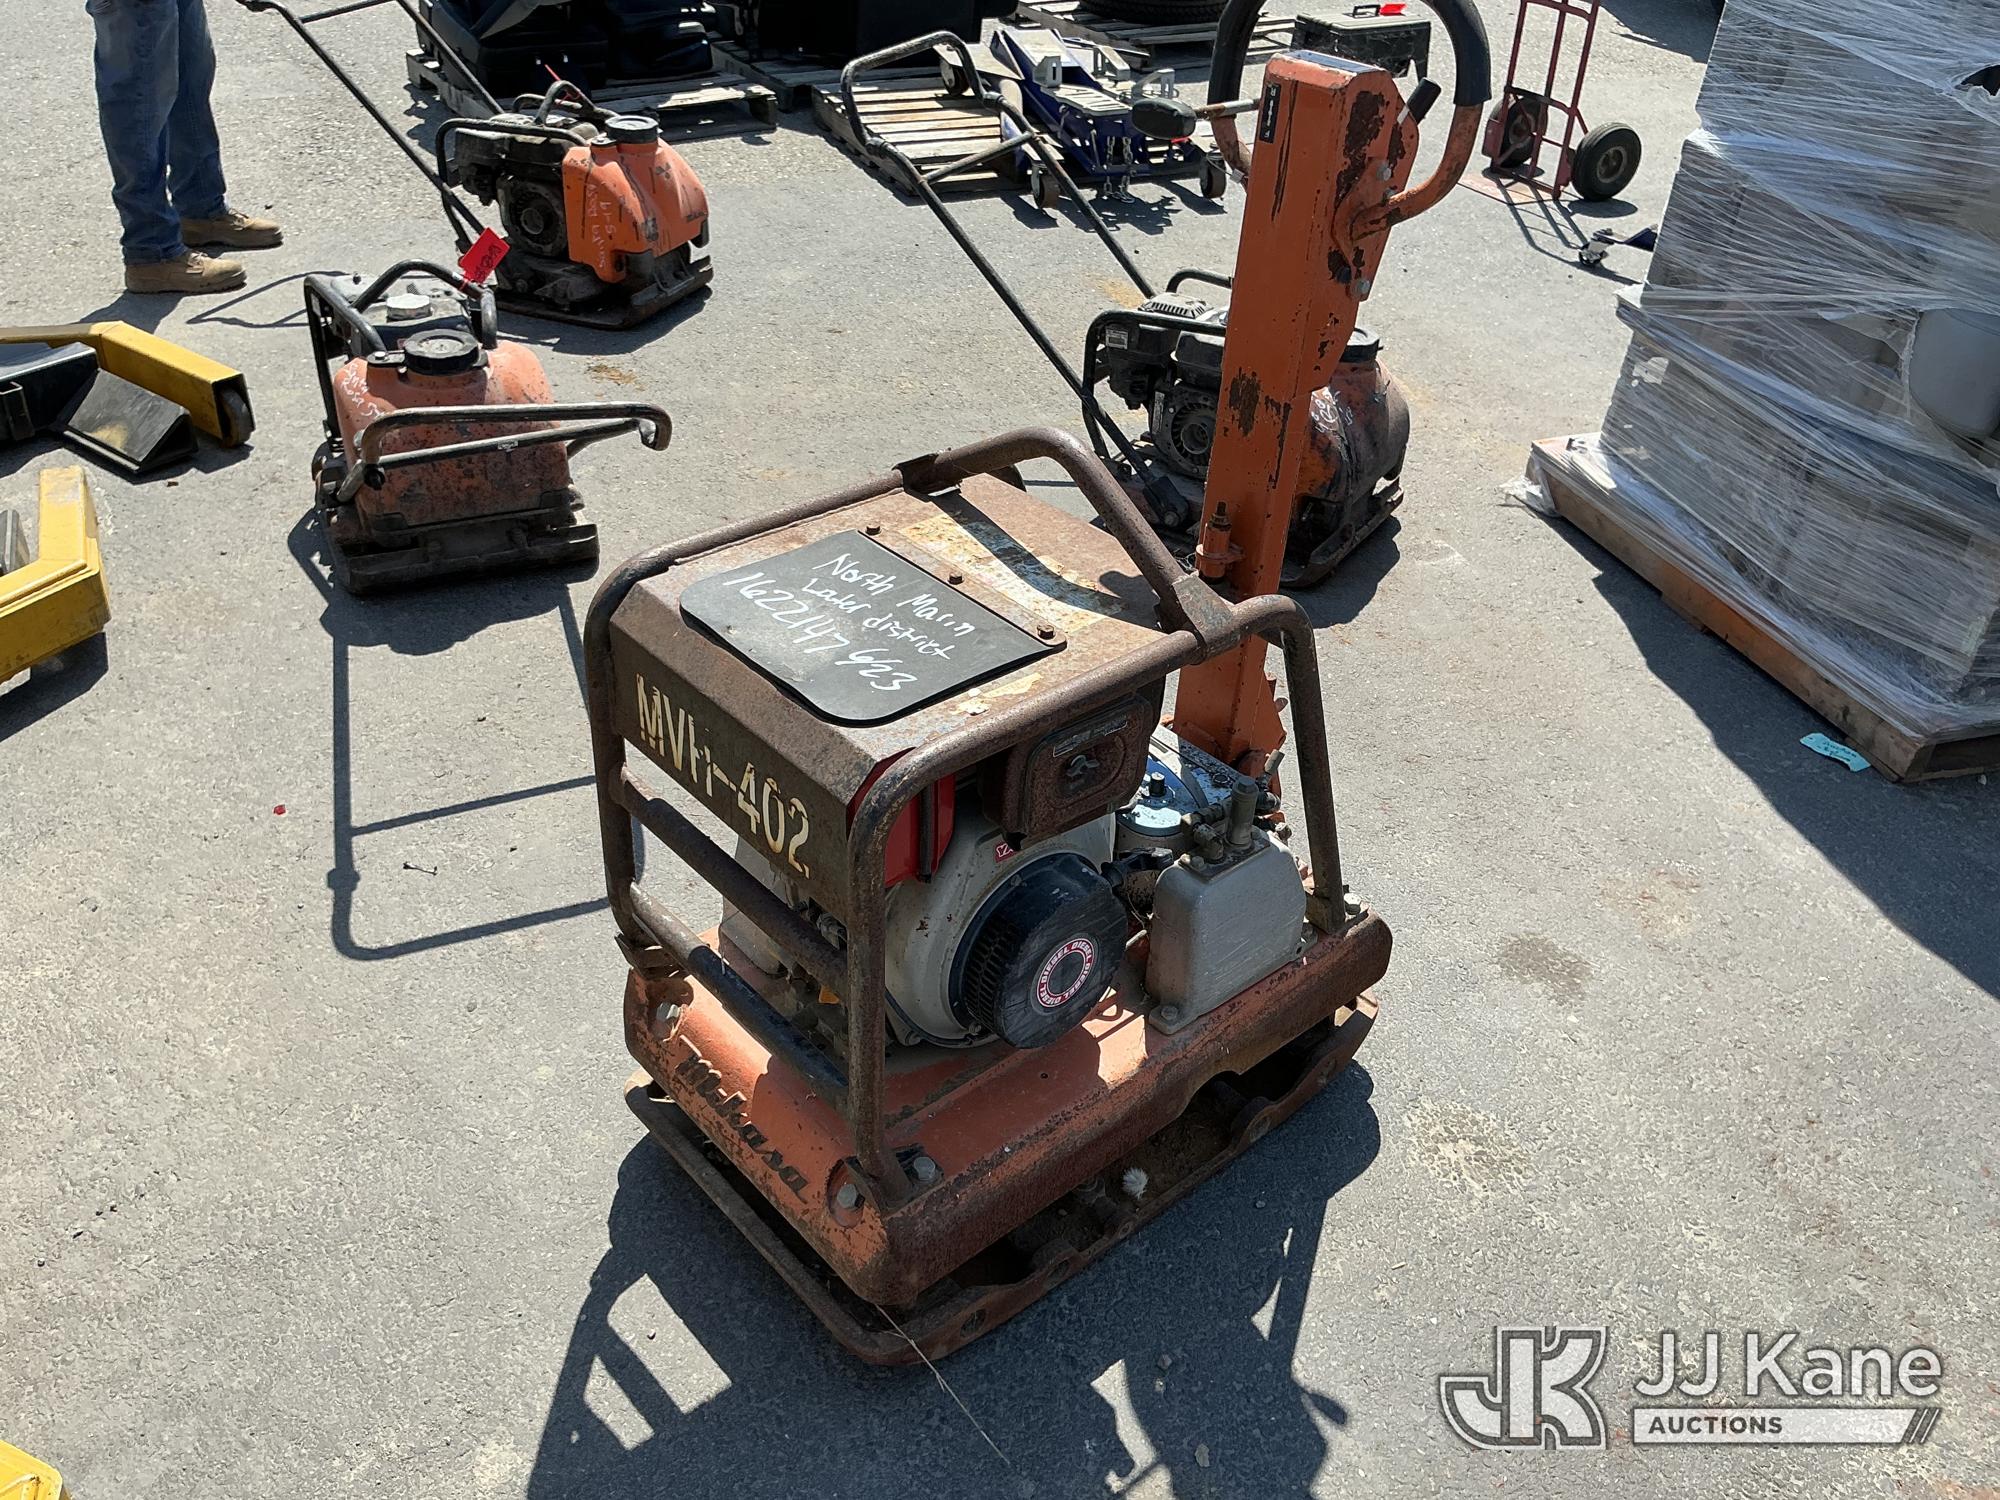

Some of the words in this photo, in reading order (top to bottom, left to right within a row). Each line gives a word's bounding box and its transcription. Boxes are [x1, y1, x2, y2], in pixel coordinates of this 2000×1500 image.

[812, 553, 896, 596] North
[896, 593, 976, 636] Marin
[722, 572, 850, 654] 1622147
[834, 648, 918, 692] 6/23
[862, 612, 956, 660] district
[1041, 947, 1070, 983] DIESEL
[1072, 941, 1092, 962] DIESEL
[1040, 983, 1061, 1005] DIESEL
